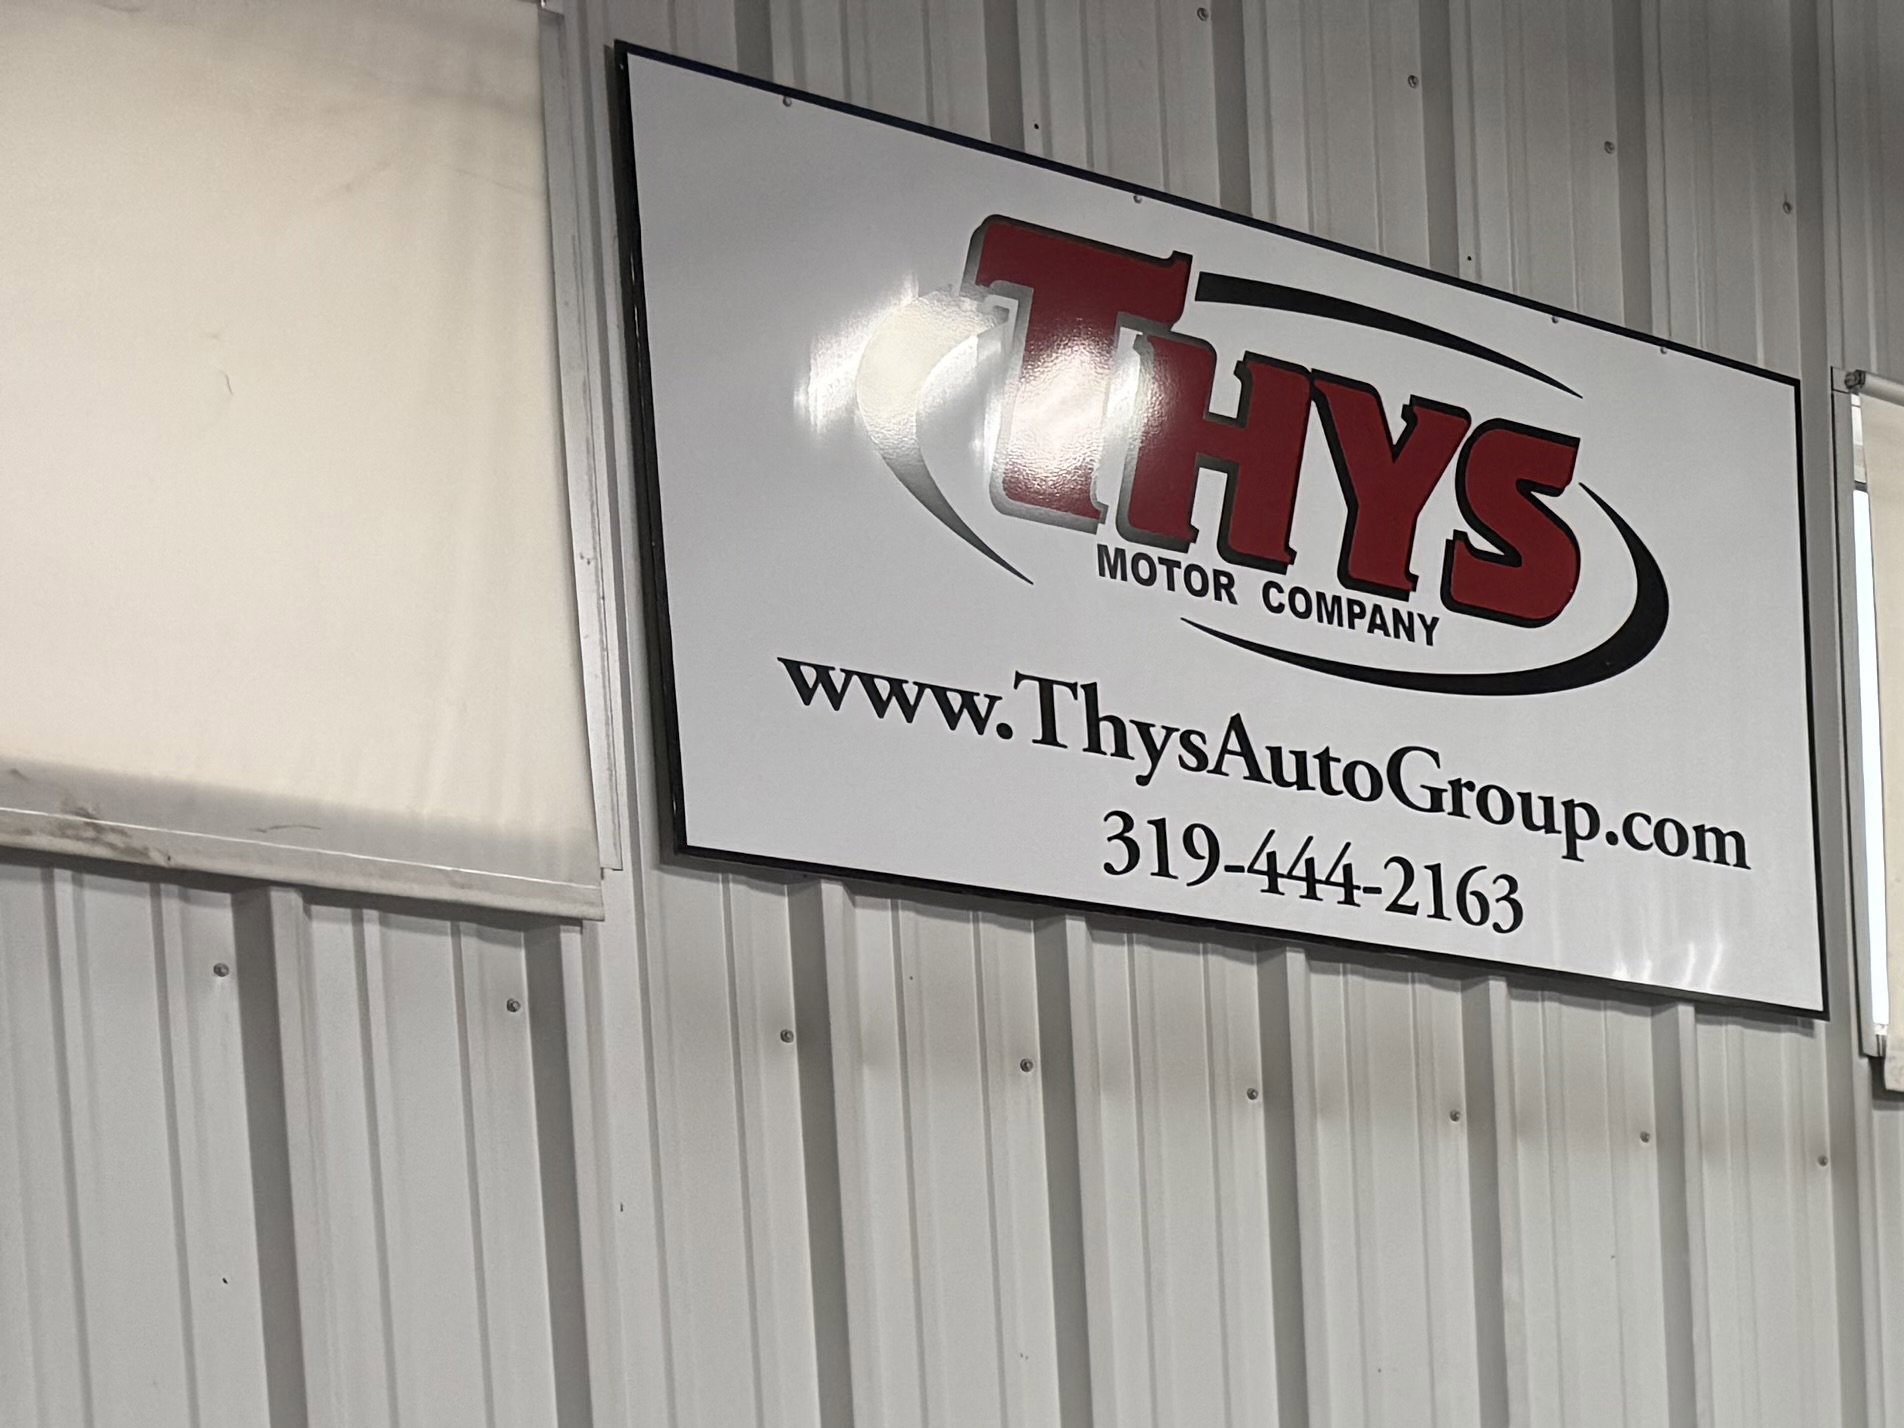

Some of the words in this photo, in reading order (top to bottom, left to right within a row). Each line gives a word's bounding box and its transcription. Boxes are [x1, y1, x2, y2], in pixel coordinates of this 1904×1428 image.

[966, 214, 1582, 629] THYS
[1096, 542, 1239, 606] MOTOR
[1262, 579, 1442, 648] COMPANY
[778, 655, 1752, 871] www.ThysAutoGroup.com
[1102, 808, 1526, 936] 319-444-2163
